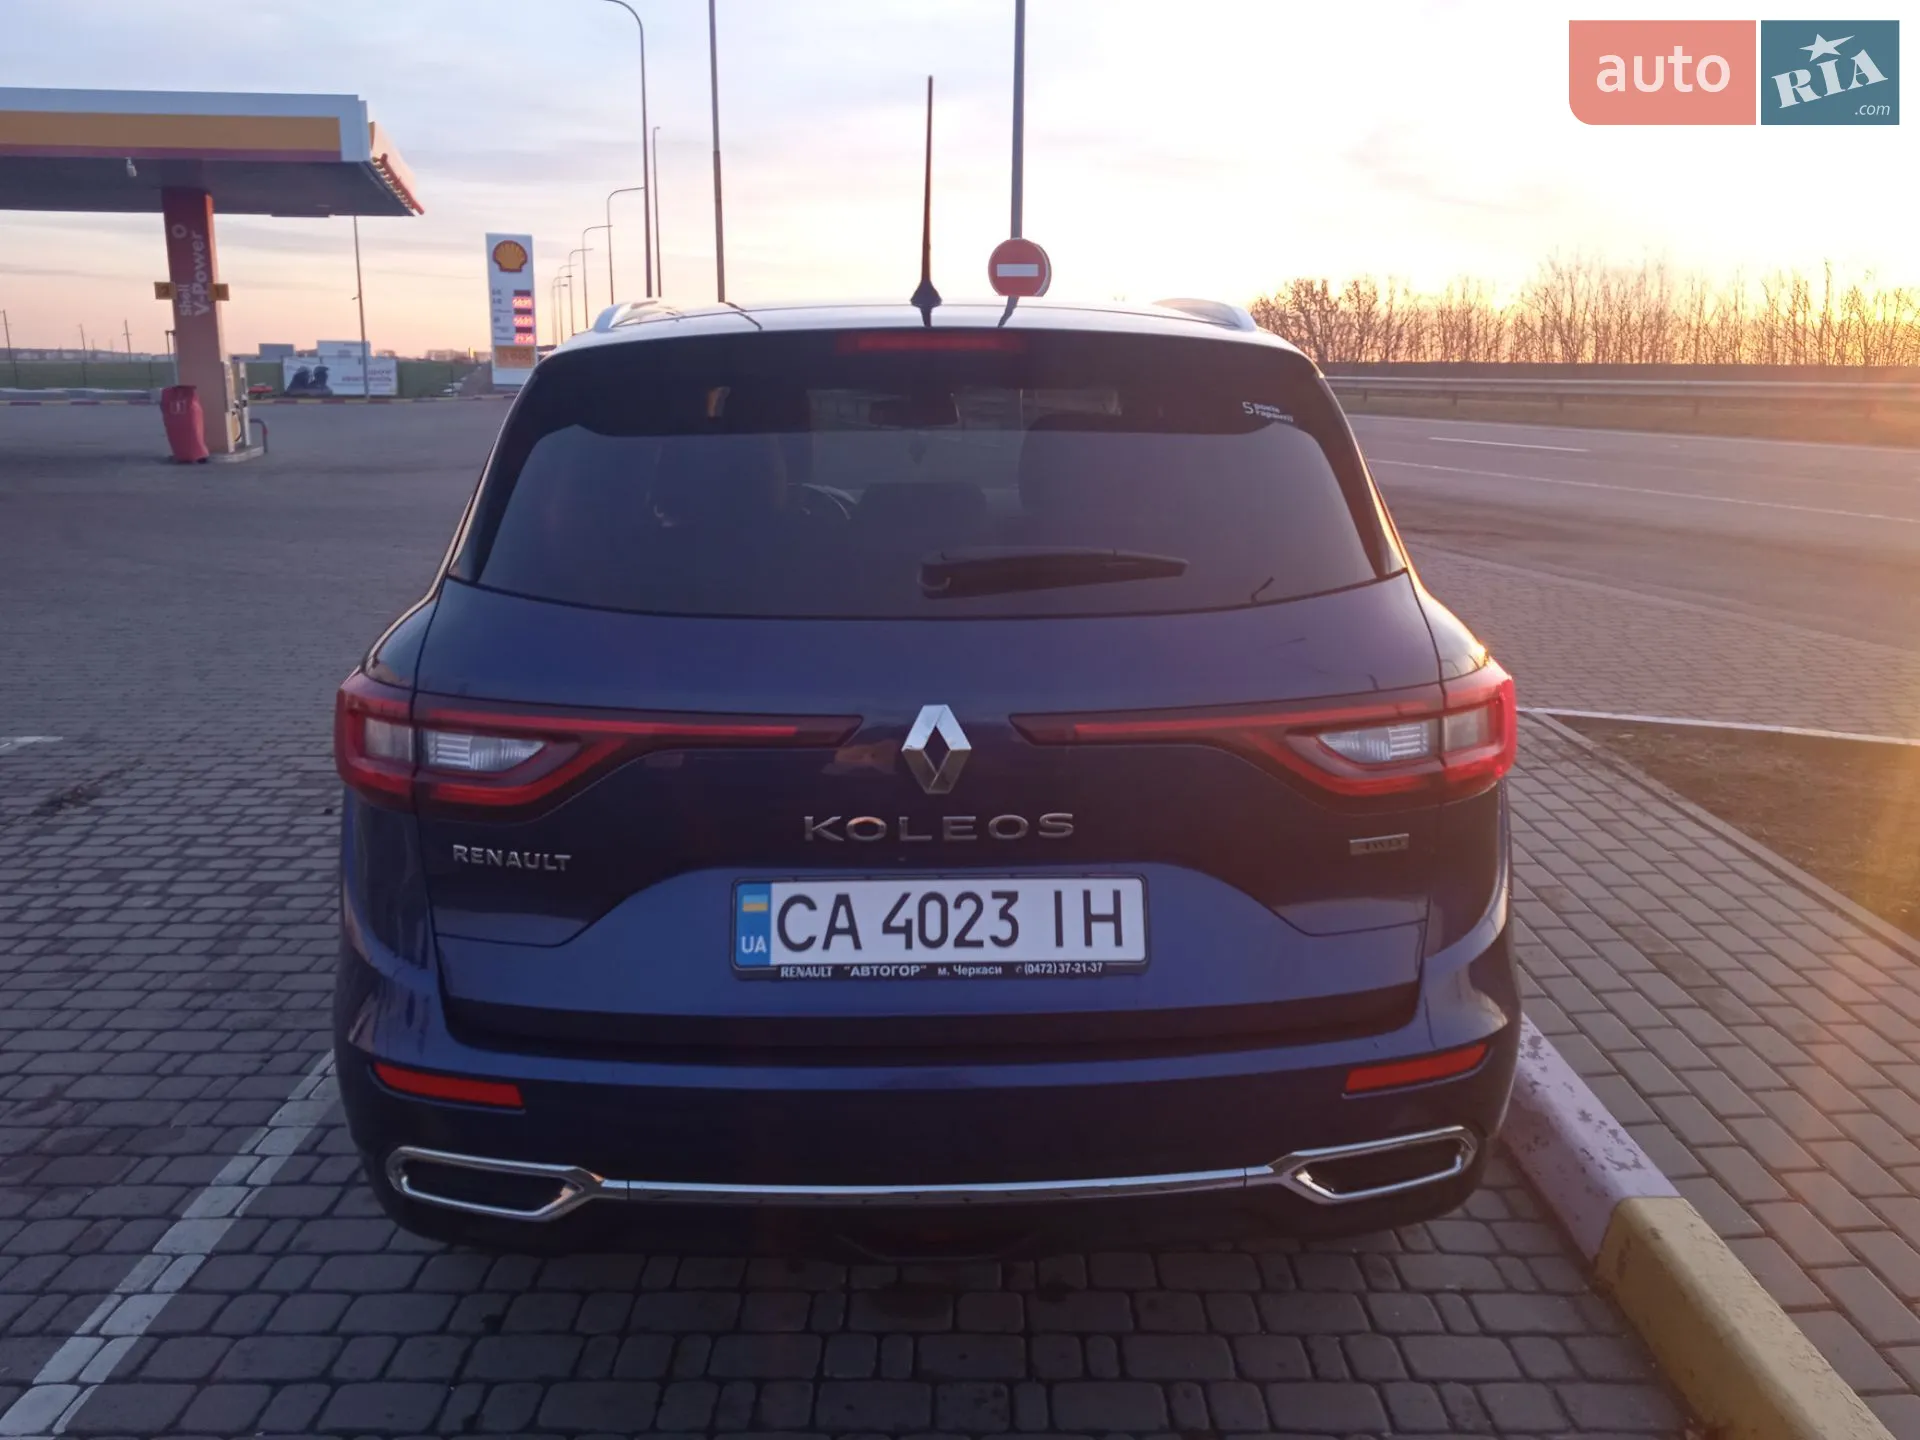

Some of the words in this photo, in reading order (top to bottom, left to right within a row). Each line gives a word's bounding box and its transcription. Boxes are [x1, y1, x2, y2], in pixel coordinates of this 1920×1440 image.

[190, 230, 211, 316] V-Power
[178, 284, 193, 316] Shell
[803, 813, 1075, 842] KOLEOS
[453, 844, 572, 872] RENAULT
[776, 893, 863, 952] CA
[881, 891, 1020, 950] 4023
[1053, 889, 1123, 948] IH
[741, 936, 767, 954] UA
[780, 966, 833, 978] RENAULT
[953, 964, 1003, 977] Черкаси
